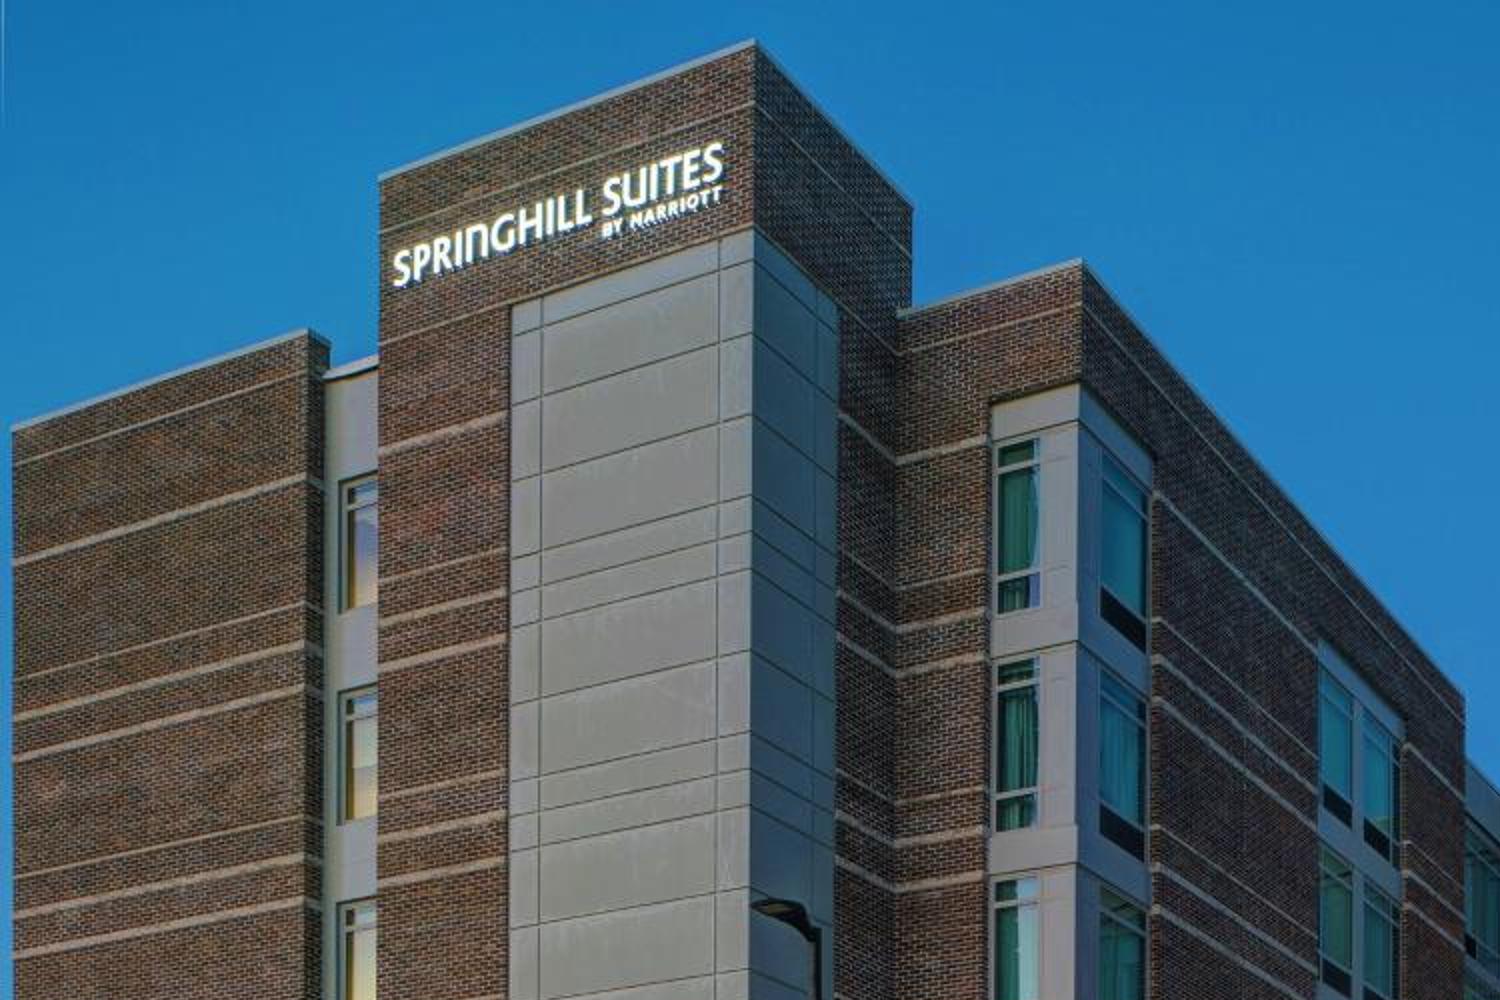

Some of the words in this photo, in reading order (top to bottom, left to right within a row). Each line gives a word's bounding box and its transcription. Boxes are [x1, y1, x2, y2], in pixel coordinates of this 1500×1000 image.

[392, 189, 593, 288] SPRINGHILL
[601, 142, 725, 217] SUITES
[601, 217, 624, 240] BY
[629, 185, 724, 231] MARRIOTT
